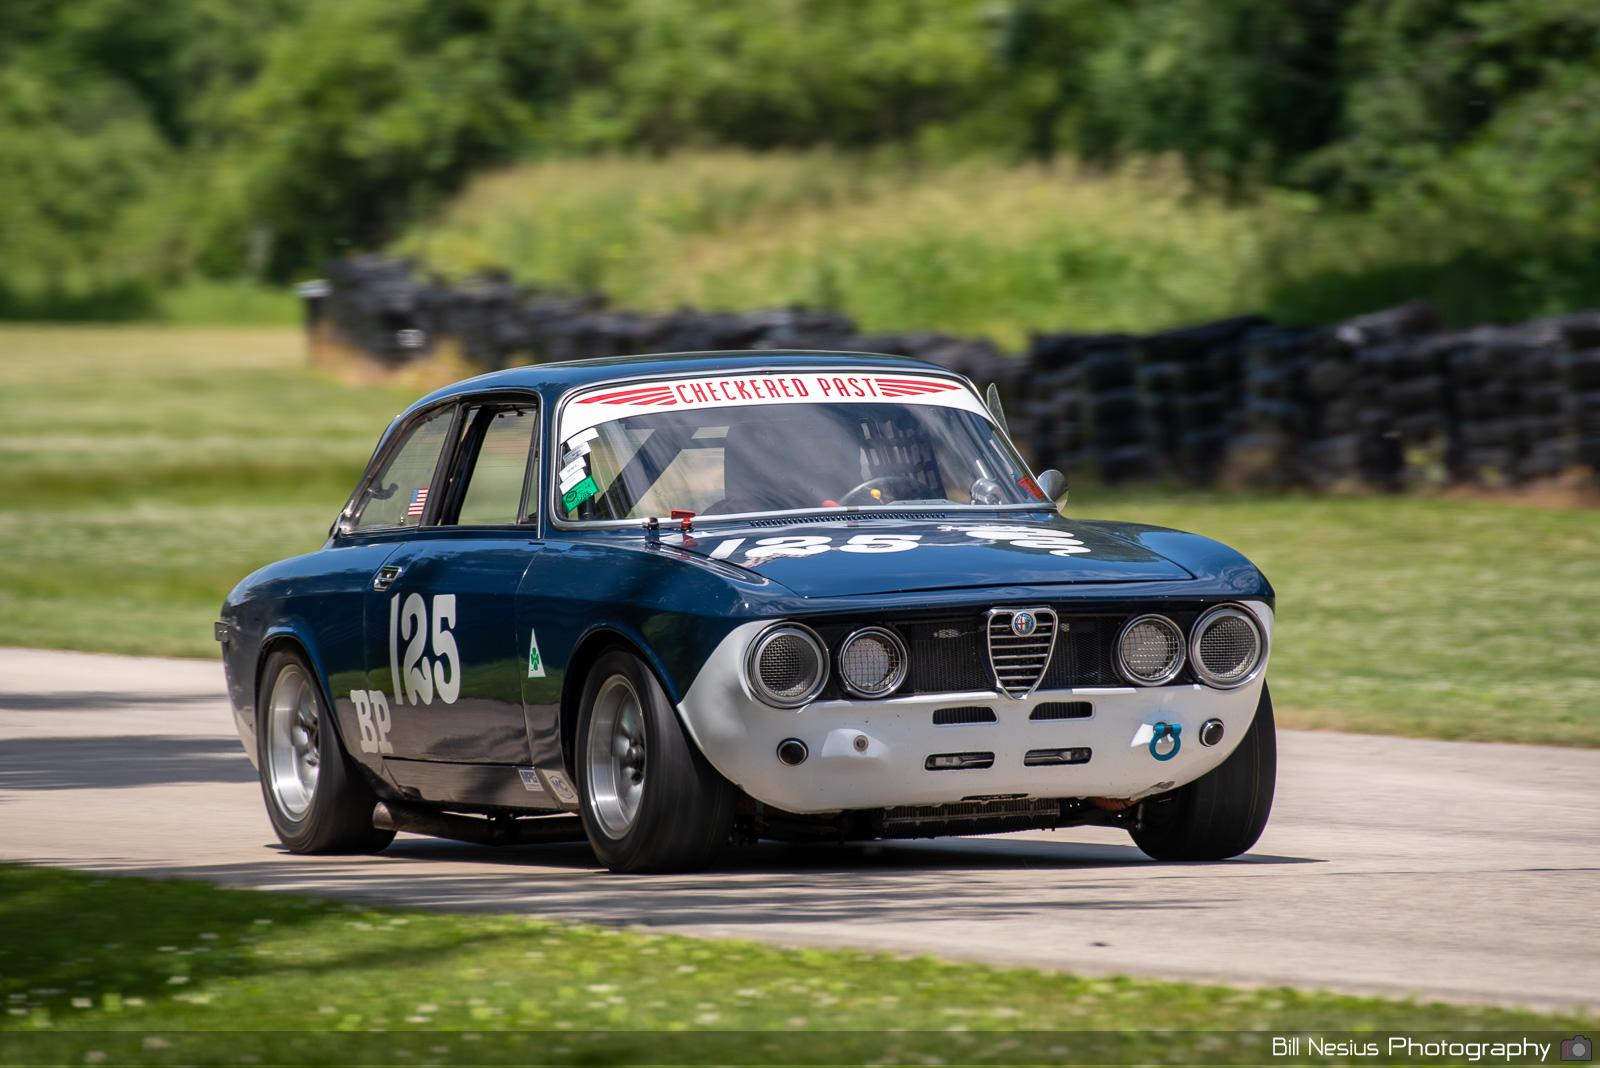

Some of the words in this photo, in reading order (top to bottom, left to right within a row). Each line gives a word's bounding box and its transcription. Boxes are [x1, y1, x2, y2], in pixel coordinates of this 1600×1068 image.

[675, 378, 810, 404] CHECKERED
[816, 377, 878, 397] PAST
[706, 534, 923, 558] 125
[389, 592, 461, 706] 125
[350, 689, 394, 754] BP
